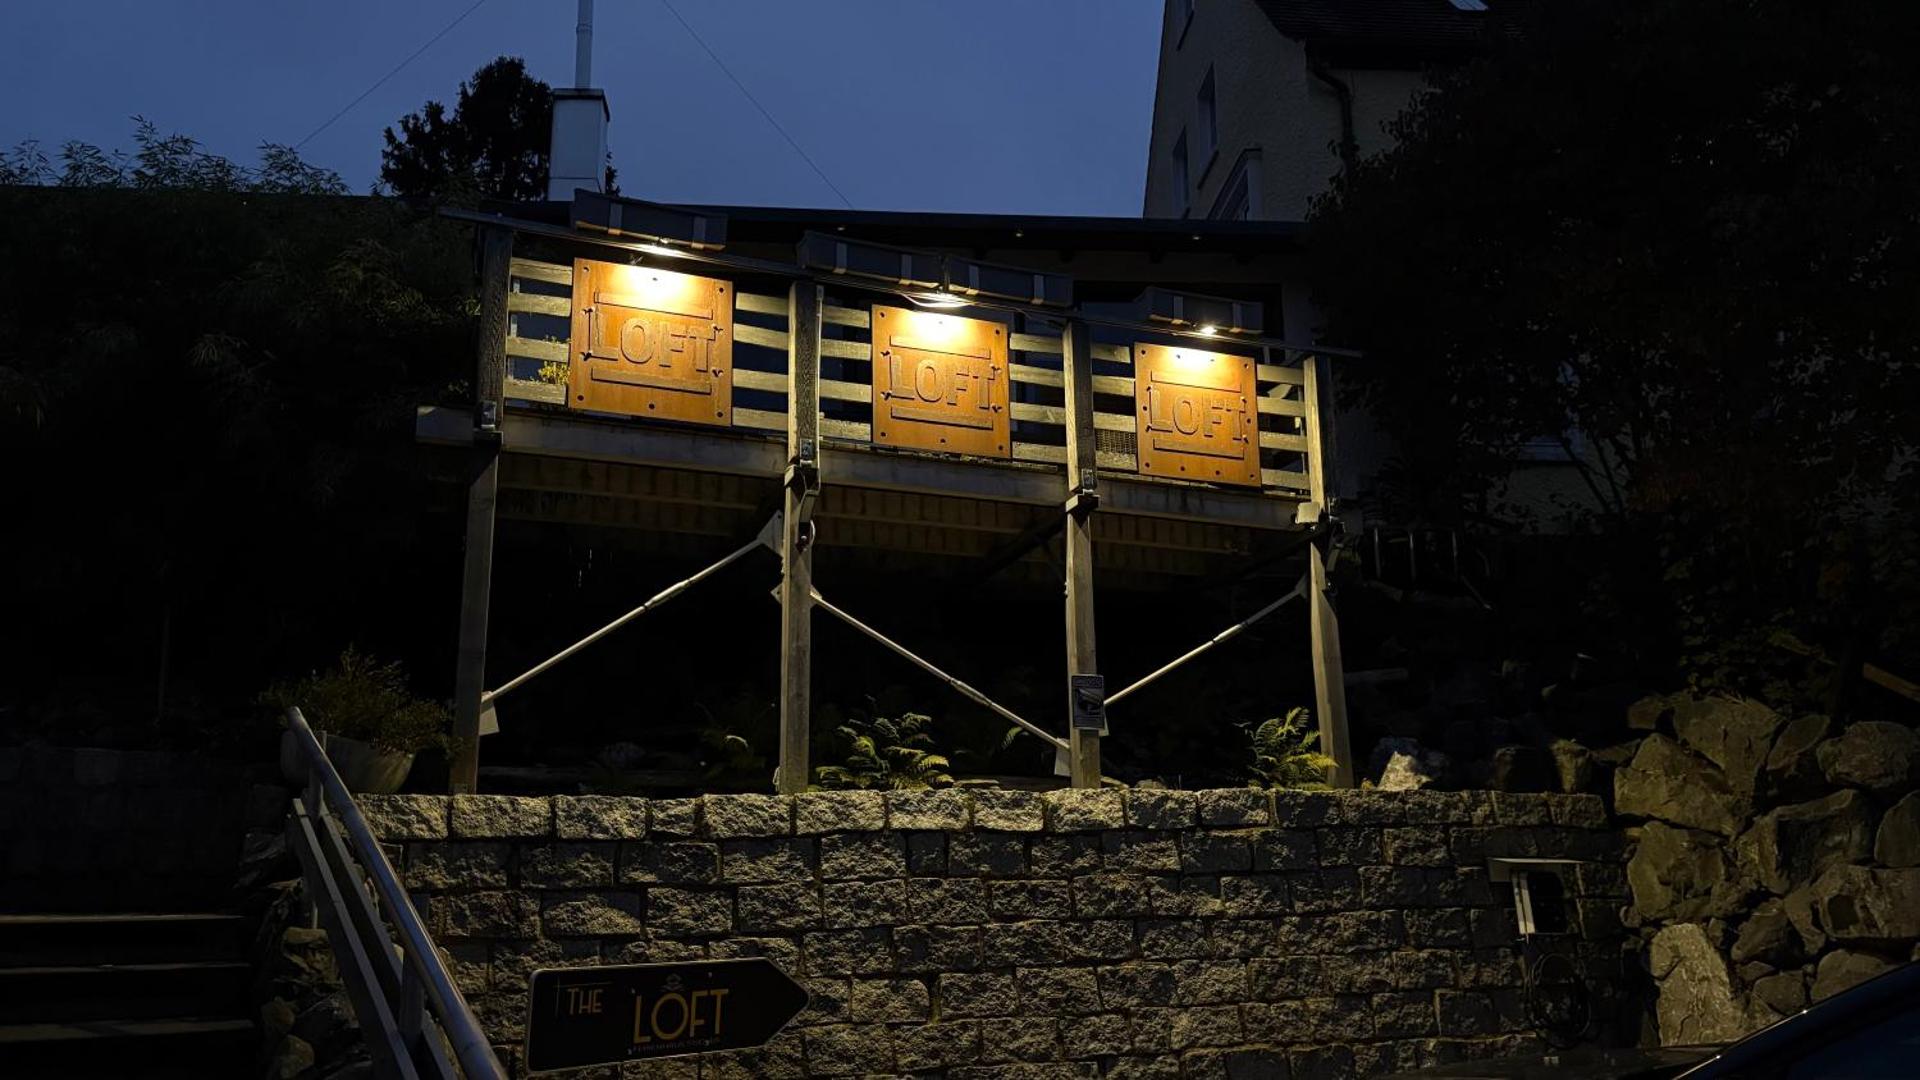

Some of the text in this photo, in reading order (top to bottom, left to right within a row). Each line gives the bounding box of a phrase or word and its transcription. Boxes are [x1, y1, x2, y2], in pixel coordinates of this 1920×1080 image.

[589, 309, 716, 373] LOFT
[889, 354, 995, 410] LOFT
[1149, 386, 1246, 441] LOFT
[567, 986, 729, 1044] THE LOFT
